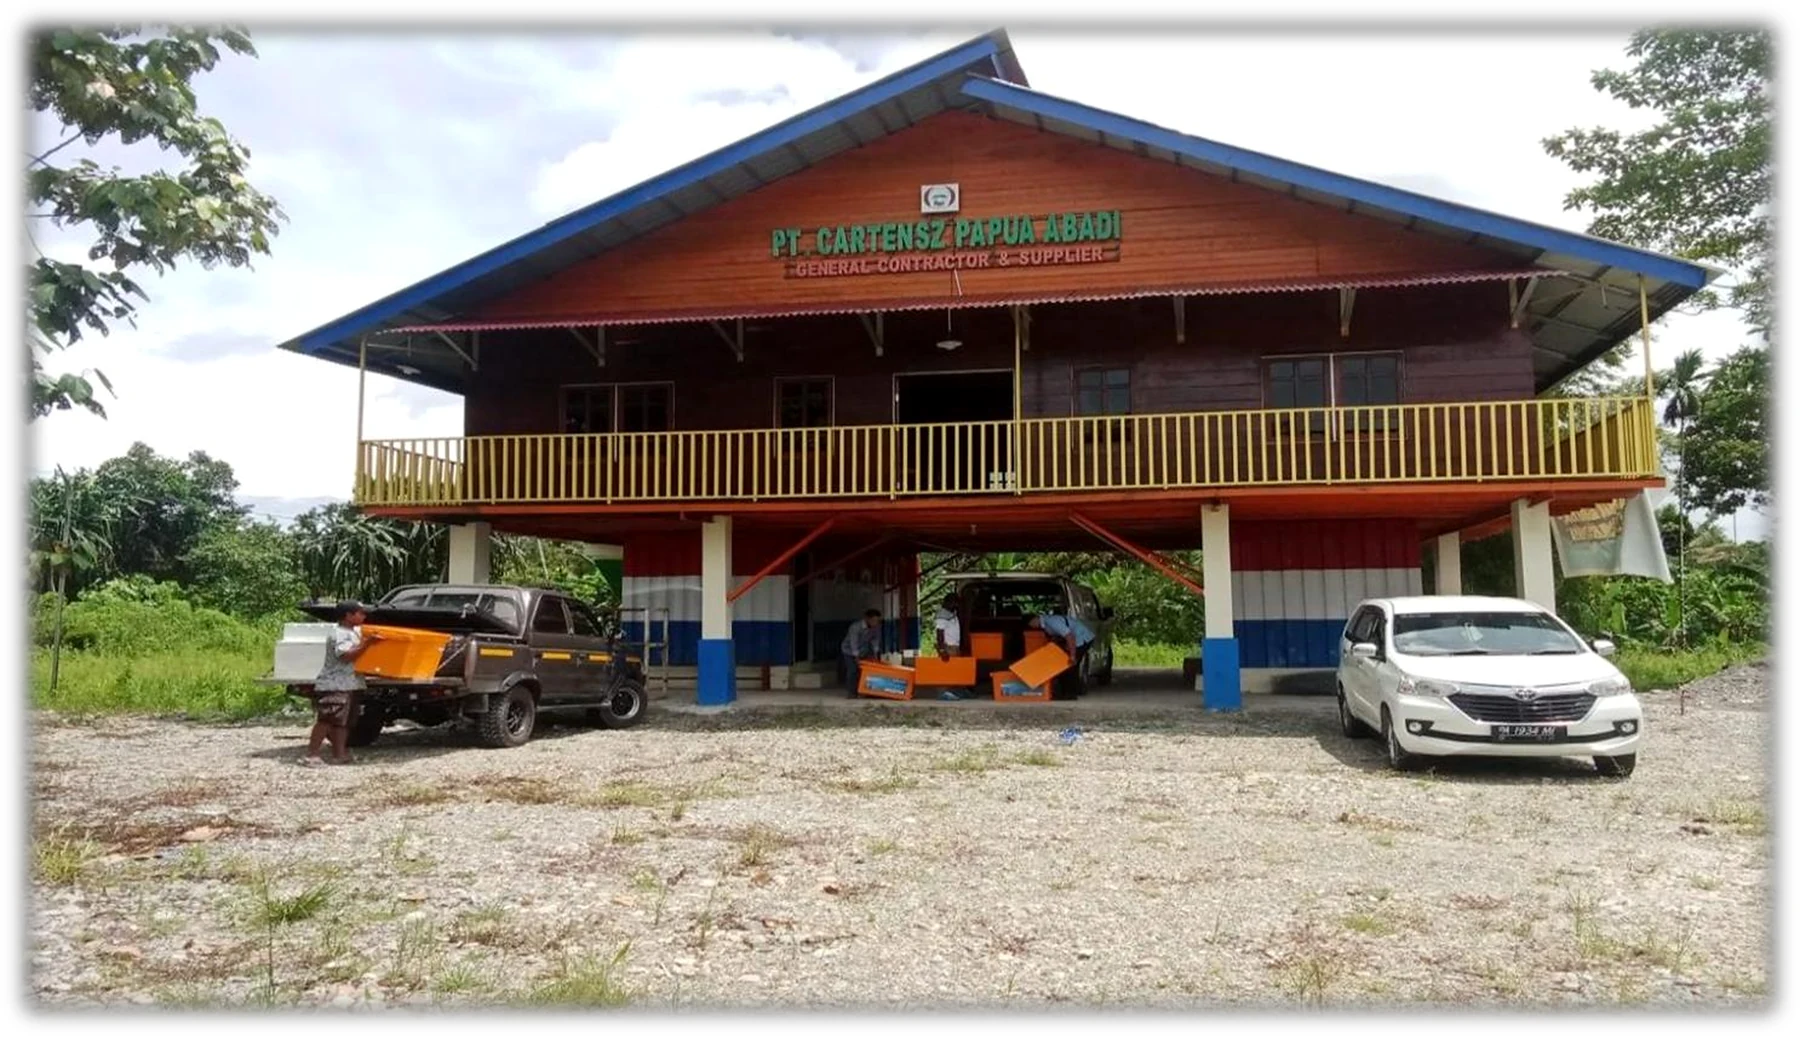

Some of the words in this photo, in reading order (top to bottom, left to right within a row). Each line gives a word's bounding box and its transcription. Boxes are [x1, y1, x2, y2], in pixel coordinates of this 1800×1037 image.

[816, 218, 946, 256] CARTENSZ
[955, 214, 1036, 248] PAPUA
[1043, 209, 1121, 243] ABADI
[795, 258, 872, 277] GENERAL
[876, 251, 990, 273] CONTRACTOR
[999, 250, 1010, 267] &
[1018, 247, 1103, 265] SUPPLIER
